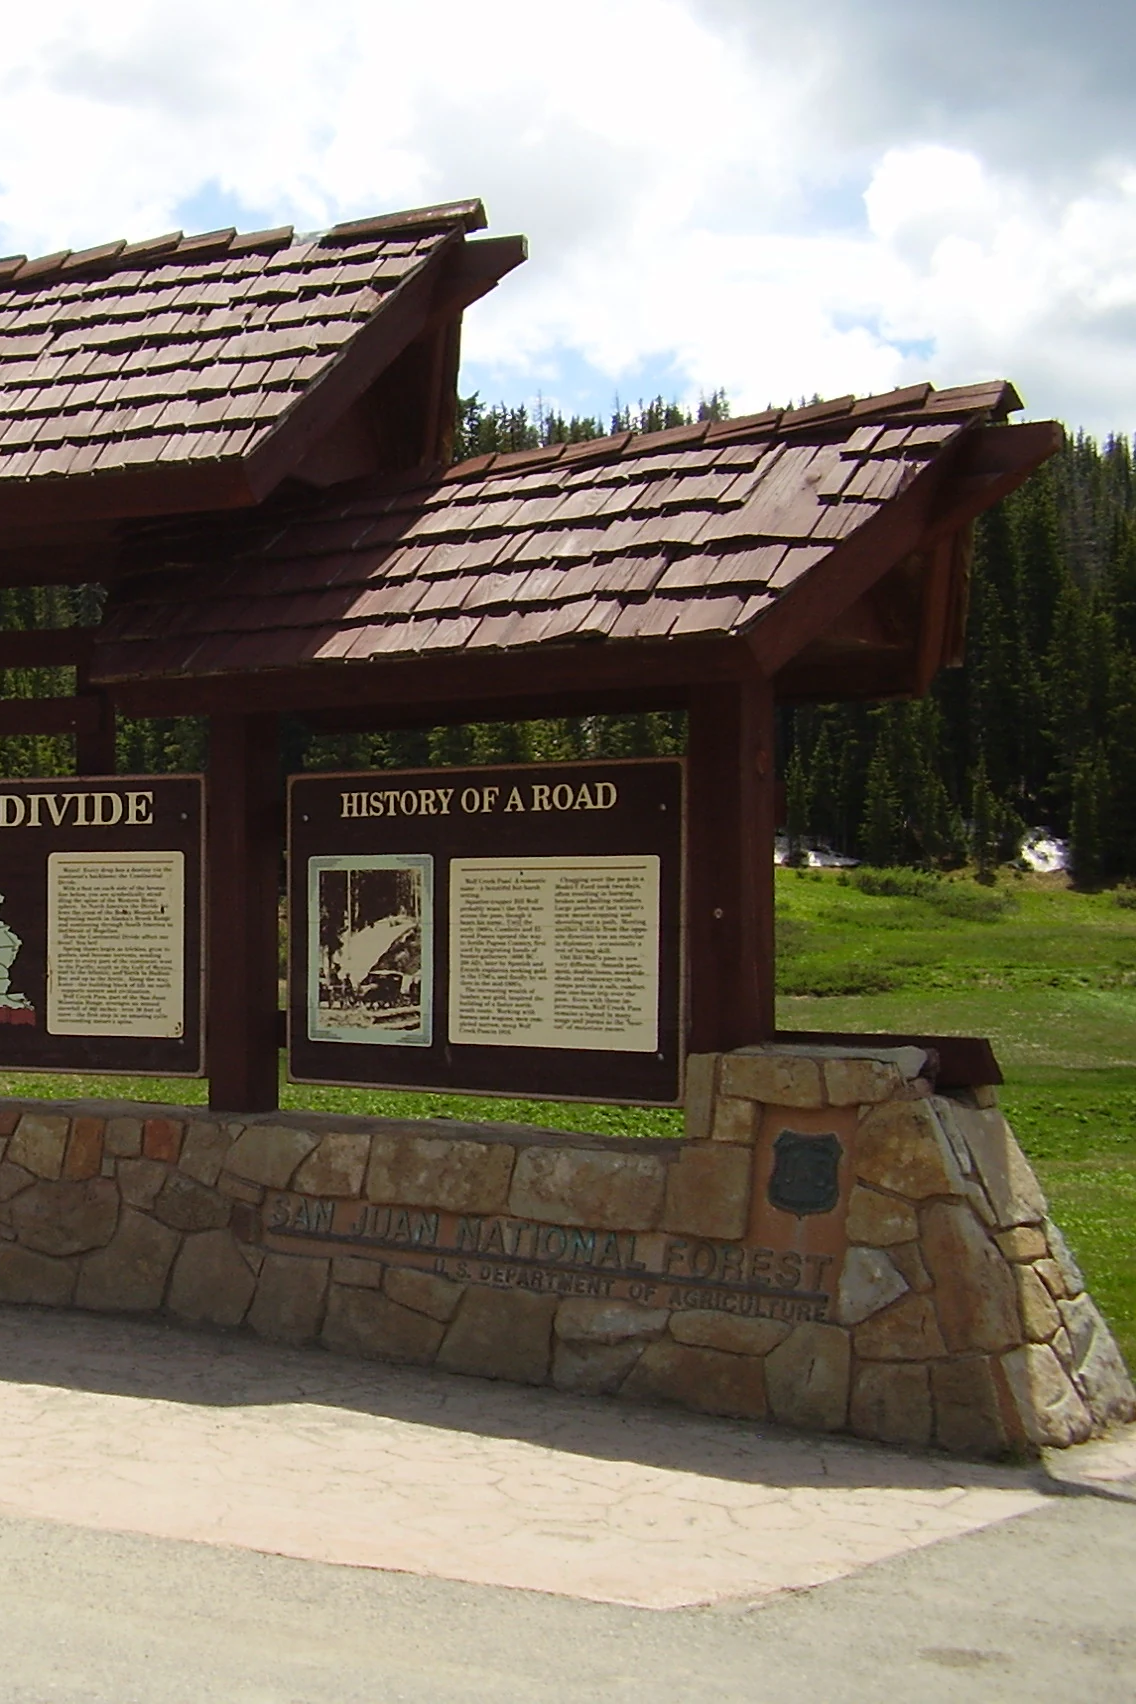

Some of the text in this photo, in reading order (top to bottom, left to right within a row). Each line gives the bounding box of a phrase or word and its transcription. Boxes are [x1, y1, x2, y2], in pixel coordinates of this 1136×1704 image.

[340, 782, 618, 818] HISTORY OF A ROAD
[268, 1193, 833, 1291] SAN JUAN NATIONAL FOREST
[456, 1260, 472, 1279] S.
[480, 1261, 616, 1295] DEPARTMENT
[628, 1283, 656, 1301] OF
[668, 1286, 829, 1323] AGRICULTURE
